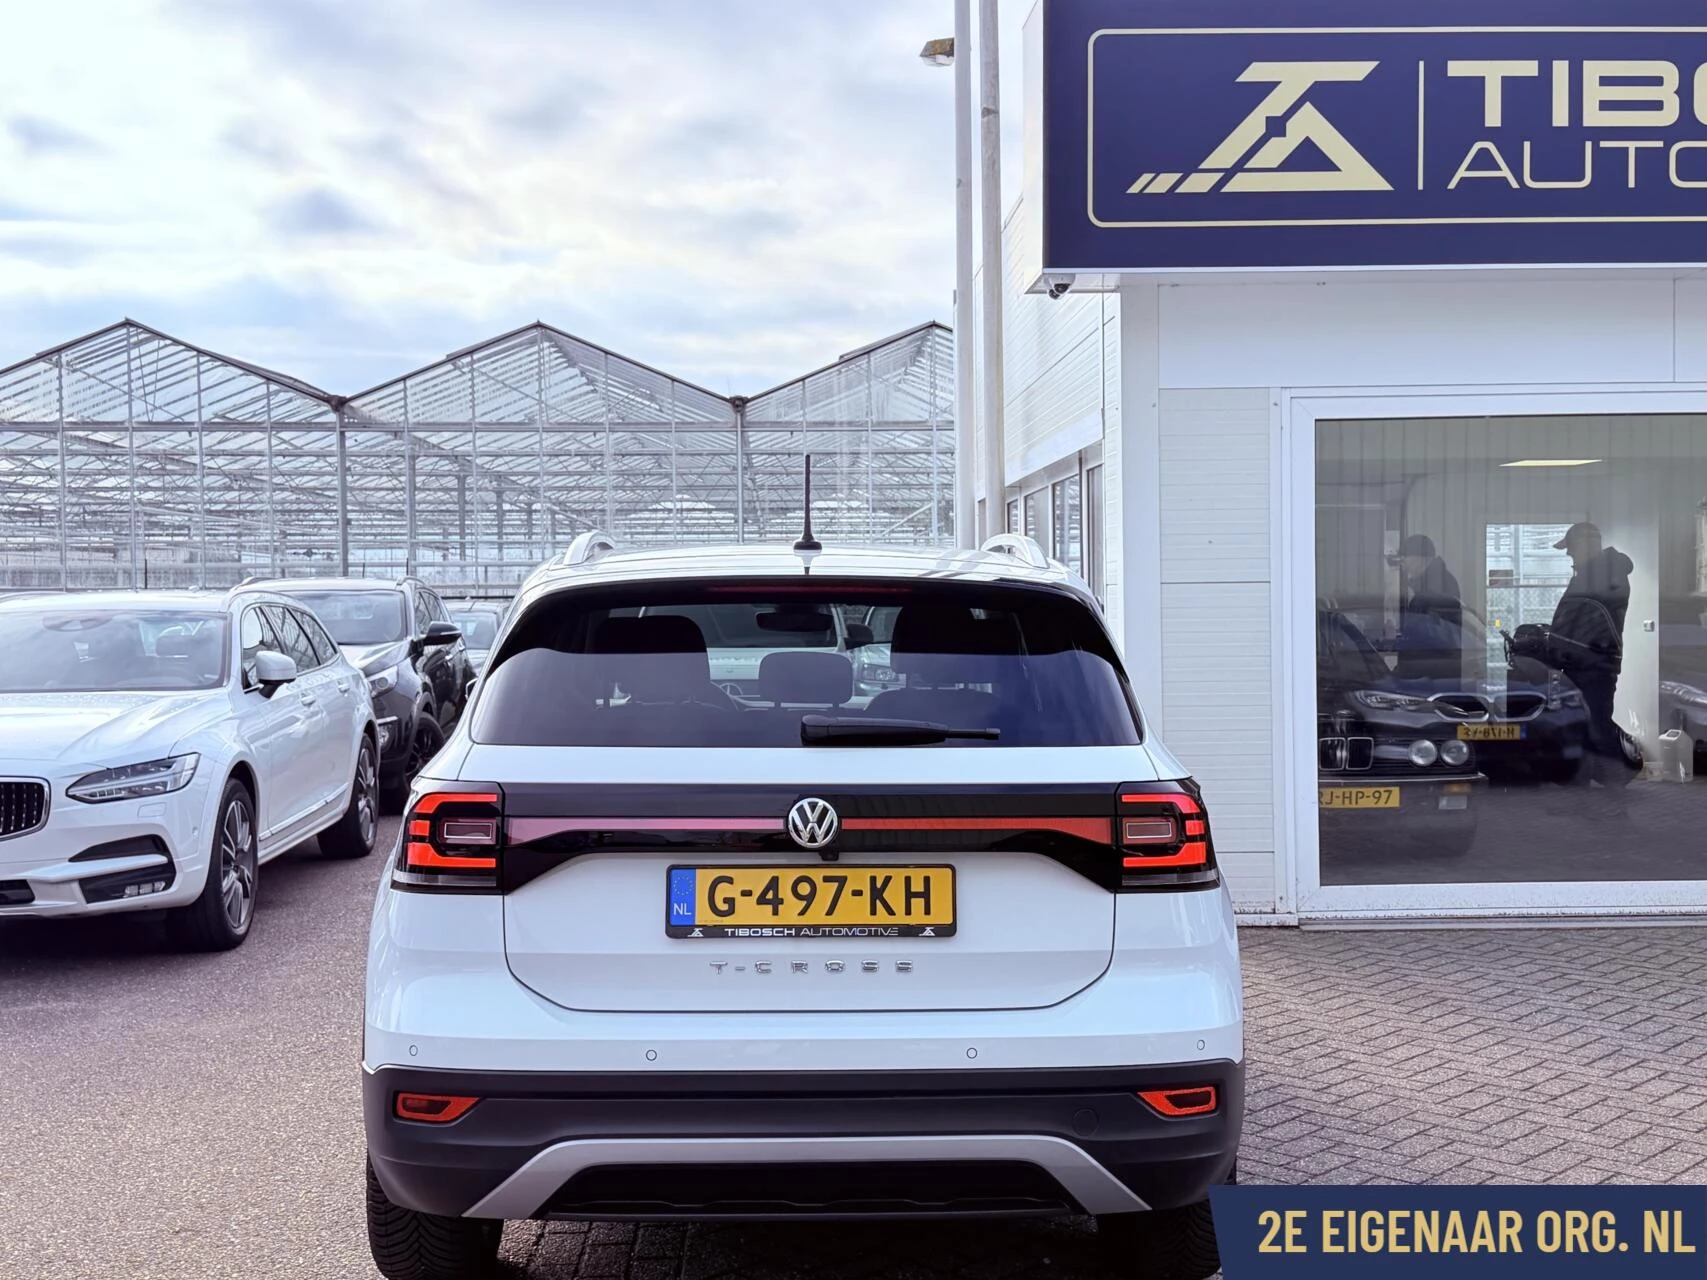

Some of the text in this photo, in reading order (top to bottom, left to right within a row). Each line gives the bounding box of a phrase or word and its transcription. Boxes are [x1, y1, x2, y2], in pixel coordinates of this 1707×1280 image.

[1447, 60, 1707, 127] TIB
[707, 875, 932, 917] G-497-KH
[673, 903, 691, 916] NL
[724, 927, 898, 936] TIBOSCH AUTOMOTIVE
[709, 960, 914, 974] T-CROSS
